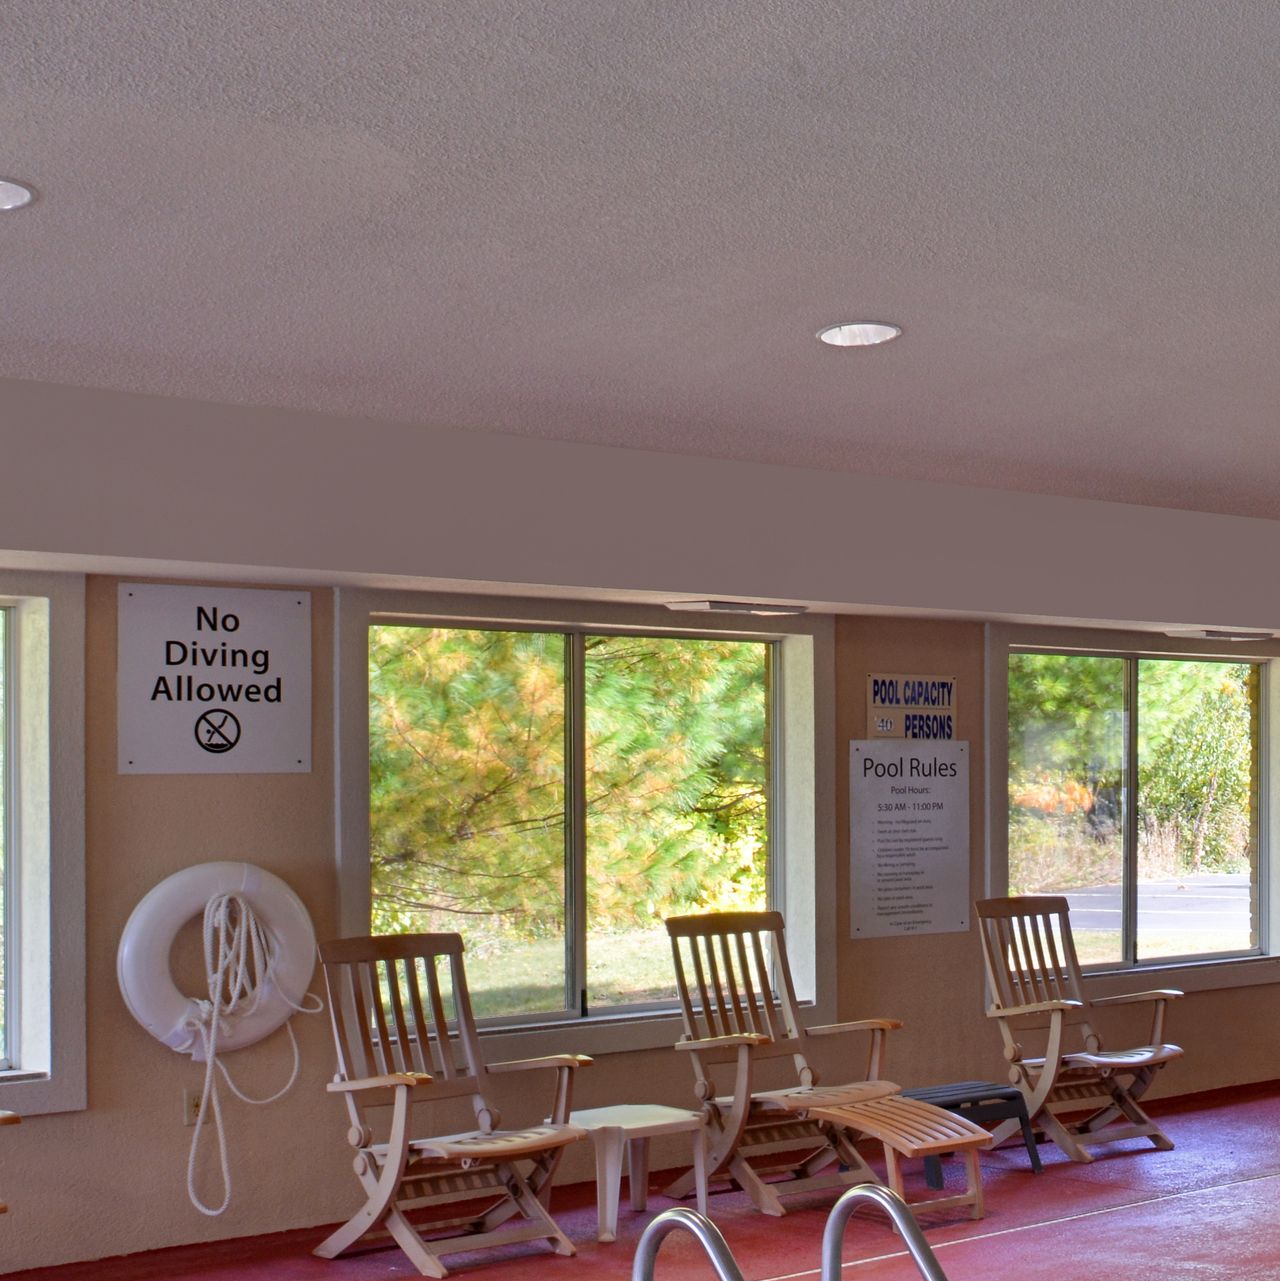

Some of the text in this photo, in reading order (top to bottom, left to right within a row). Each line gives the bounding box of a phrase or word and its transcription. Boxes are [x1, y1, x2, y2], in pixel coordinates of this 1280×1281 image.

[196, 606, 240, 633] No
[164, 640, 270, 675] Diving
[150, 675, 282, 703] Allowed
[872, 678, 954, 707] POOL CAPACITY
[877, 714, 953, 740] 40 PERSONS
[863, 756, 958, 778] Pool Rules
[890, 785, 907, 796] Pool
[877, 803, 894, 812] 5:30
[894, 802, 907, 812] AM
[912, 802, 930, 811] 11:00
[930, 802, 944, 811] PM
